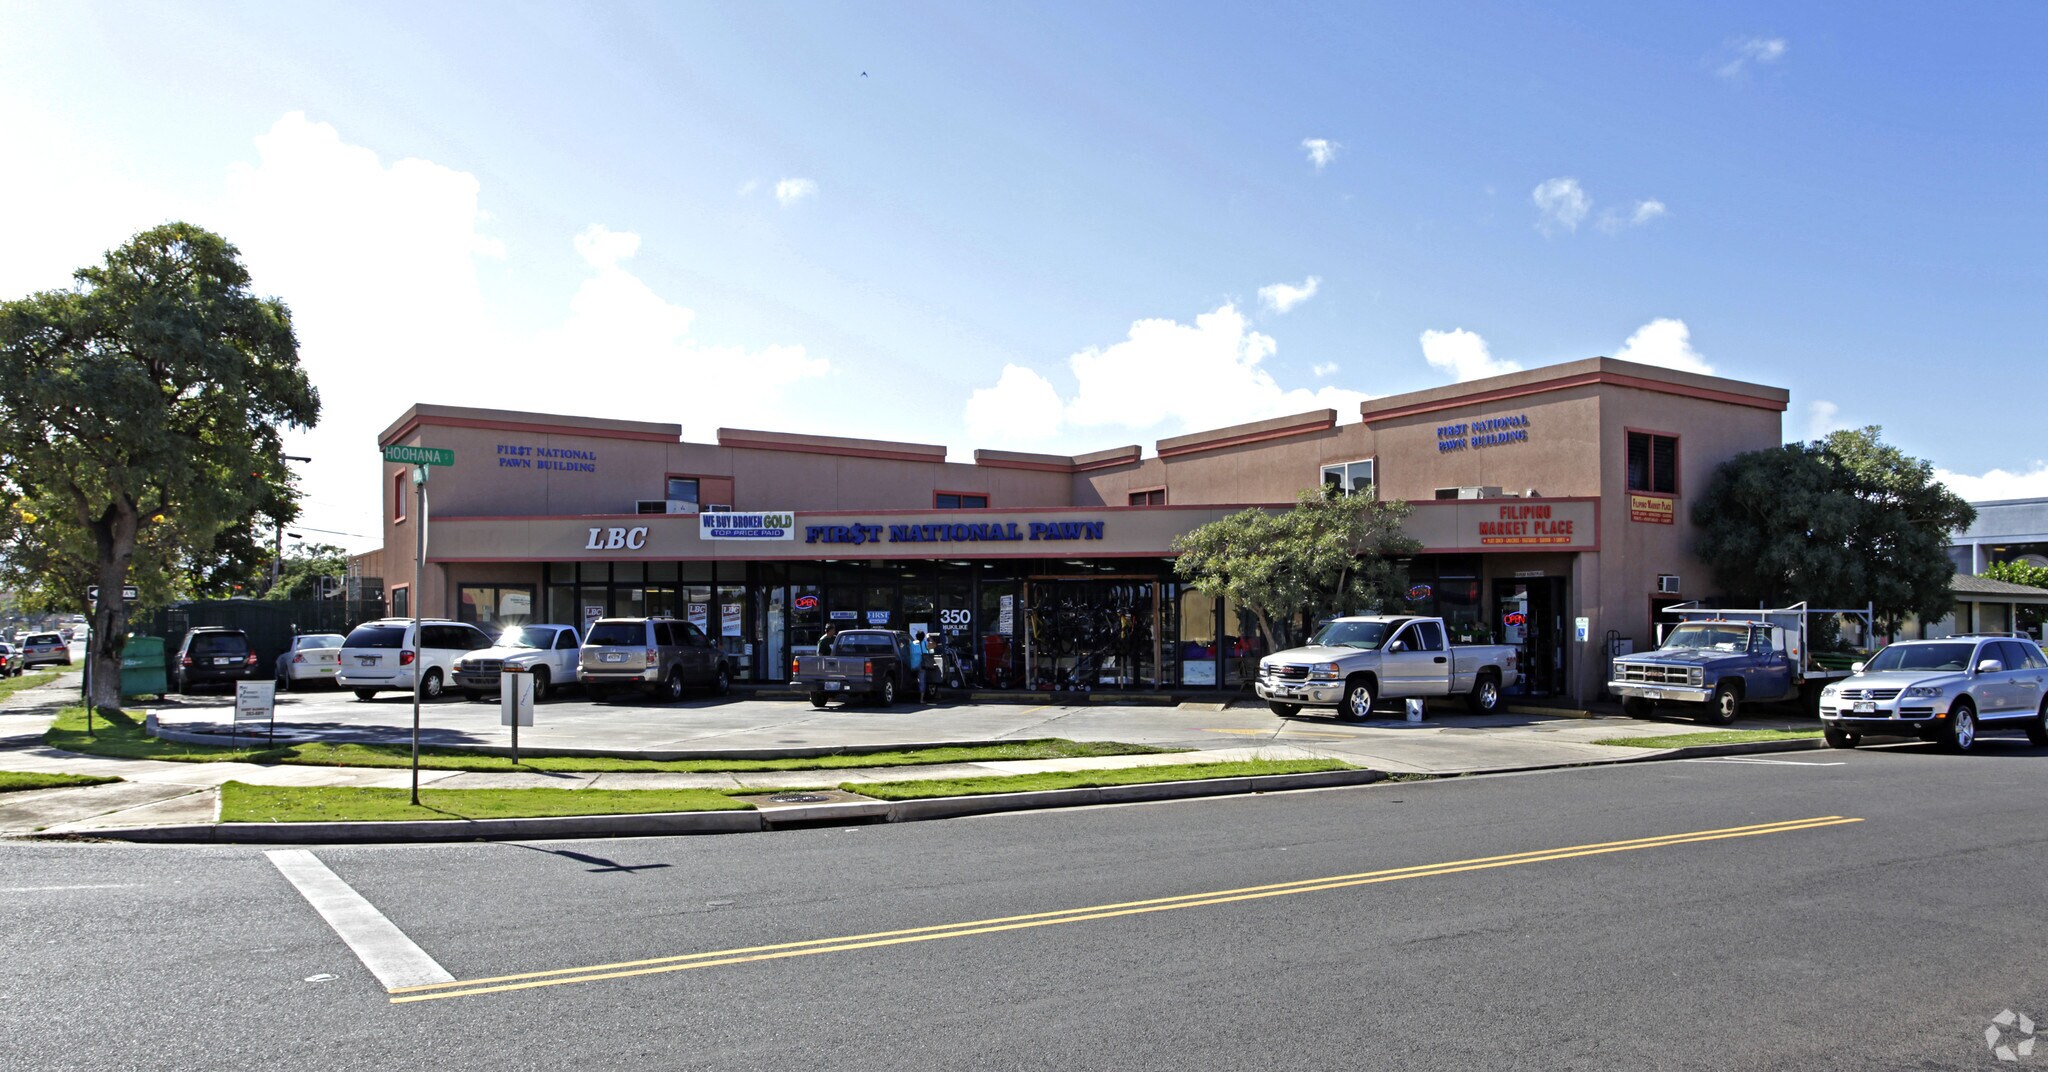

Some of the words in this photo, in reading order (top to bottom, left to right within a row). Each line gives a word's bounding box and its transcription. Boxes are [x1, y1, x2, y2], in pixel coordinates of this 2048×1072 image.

[1471, 414, 1527, 432] NATIONAL
[1438, 437, 1466, 451] PAWN
[1471, 429, 1527, 447] BUILDING
[385, 446, 441, 463] HOOHANA
[536, 447, 597, 461] NATIONAL
[499, 457, 531, 469] PAWN
[537, 460, 596, 473] BUILDING
[1500, 505, 1552, 520] FILIPINO
[703, 515, 715, 528] WE
[716, 515, 731, 528] BUY
[732, 515, 763, 528] BROKEN
[763, 514, 793, 529] GOLD
[1479, 521, 1528, 536] MARKET
[1534, 520, 1573, 535] PLACE
[585, 527, 648, 550] LBC
[888, 523, 1023, 543] NATIONAL
[1029, 521, 1105, 541] PAWN
[689, 605, 706, 613] LBC
[795, 597, 818, 607] OPEN
[586, 608, 602, 616] LBC
[723, 606, 740, 614] LBC
[866, 611, 891, 620] FIRST
[940, 609, 971, 624] 350
[1504, 614, 1526, 625] OPEN
